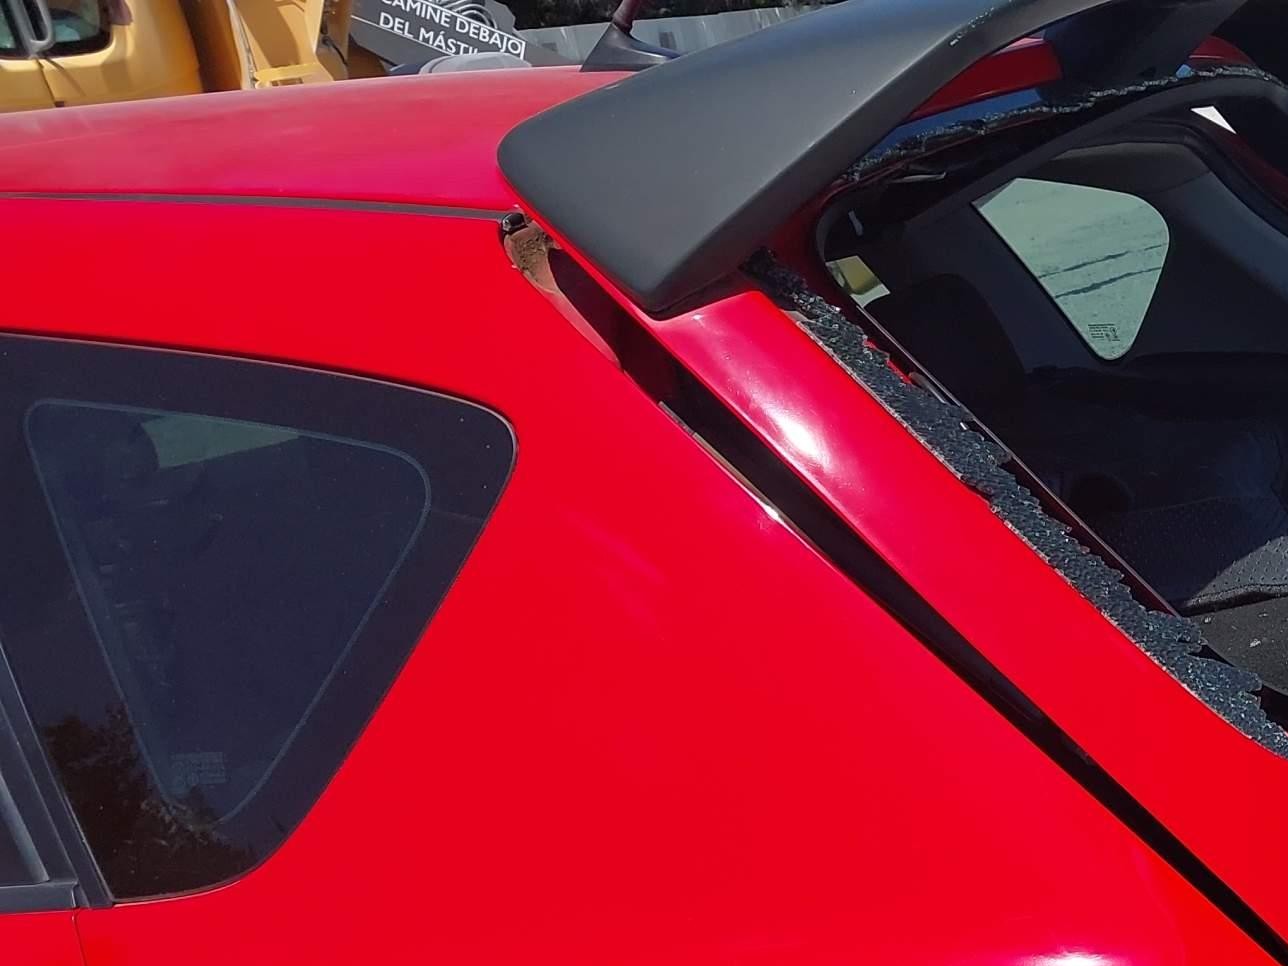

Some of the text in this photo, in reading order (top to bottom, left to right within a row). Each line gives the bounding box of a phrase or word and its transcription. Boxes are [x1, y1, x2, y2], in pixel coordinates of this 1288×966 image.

[379, 12, 414, 39] DEL
[382, 0, 521, 54] AMINE DEBAJO
